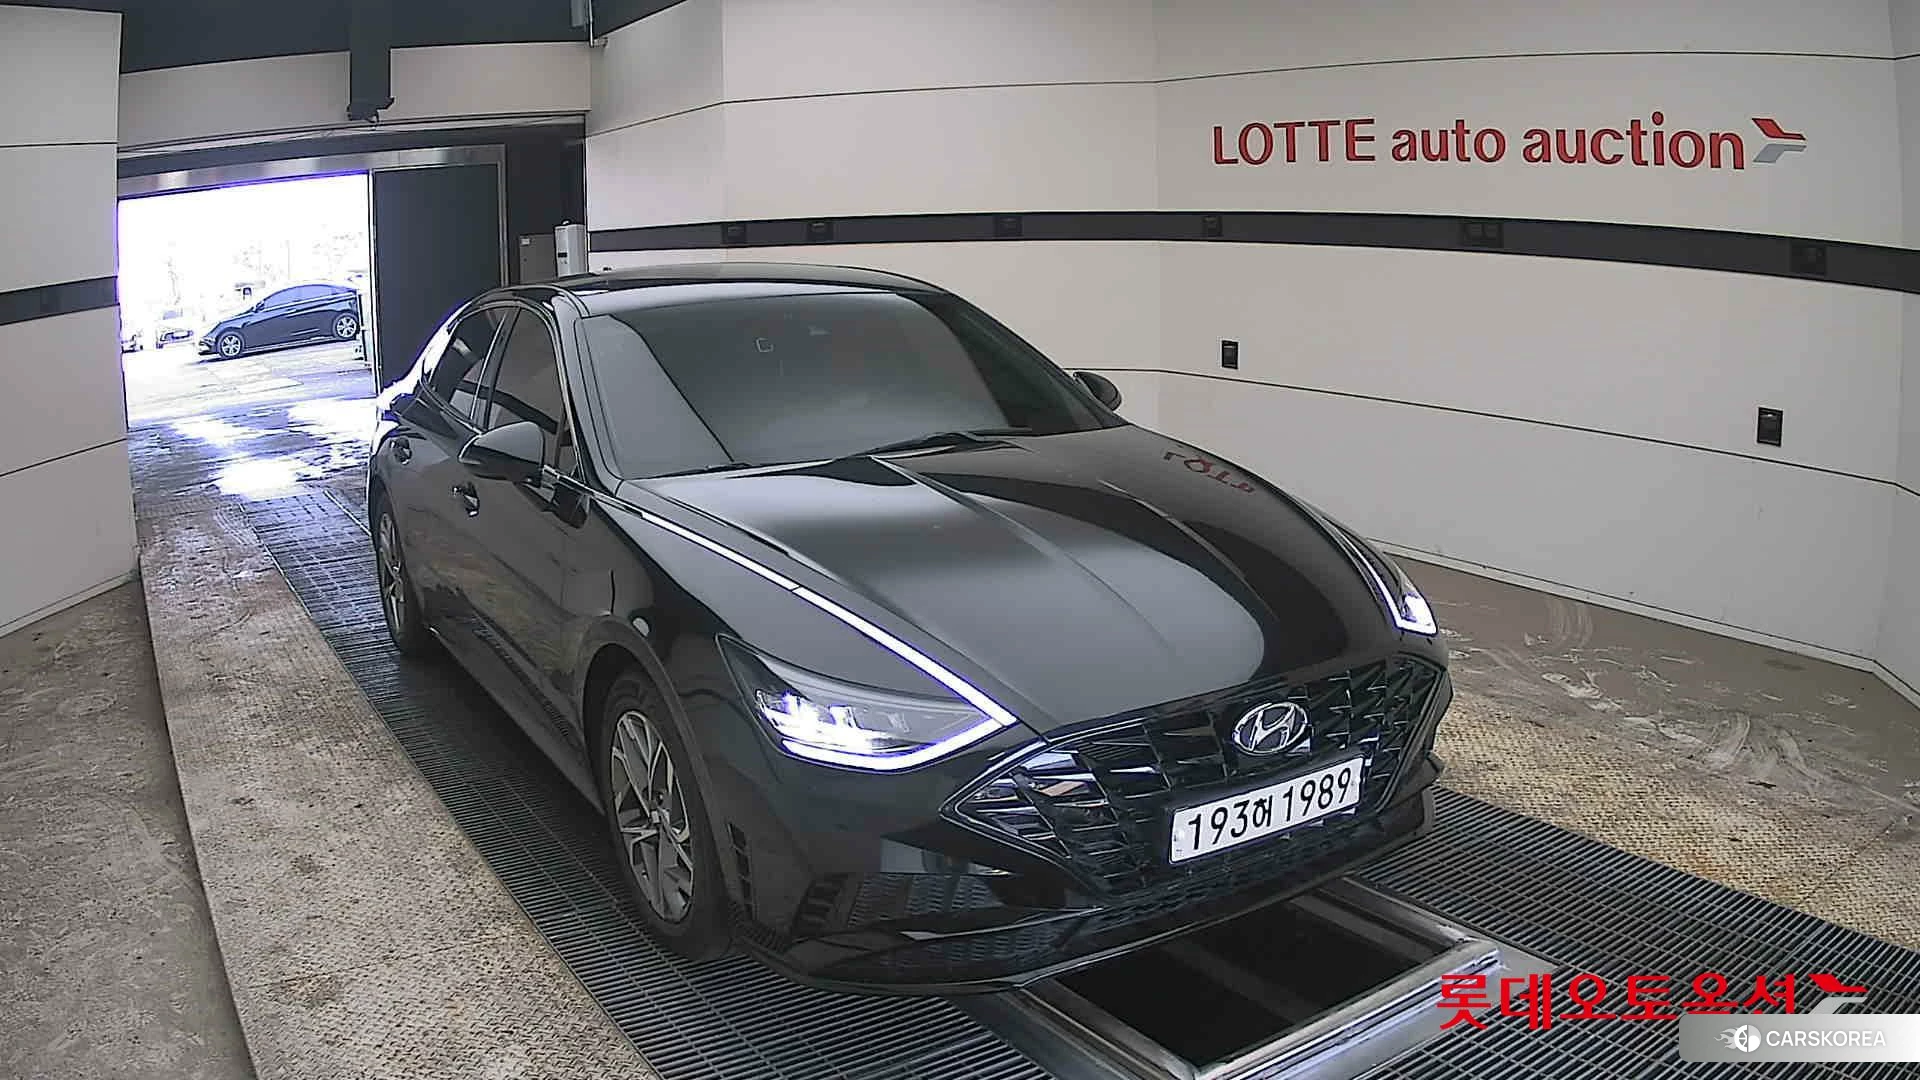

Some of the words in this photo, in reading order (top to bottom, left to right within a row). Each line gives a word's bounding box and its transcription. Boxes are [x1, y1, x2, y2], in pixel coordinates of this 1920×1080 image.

[1213, 118, 1376, 165] LOTTE
[1392, 119, 1507, 163] auto
[1522, 112, 1745, 170] auction
[1282, 767, 1351, 823] 1989
